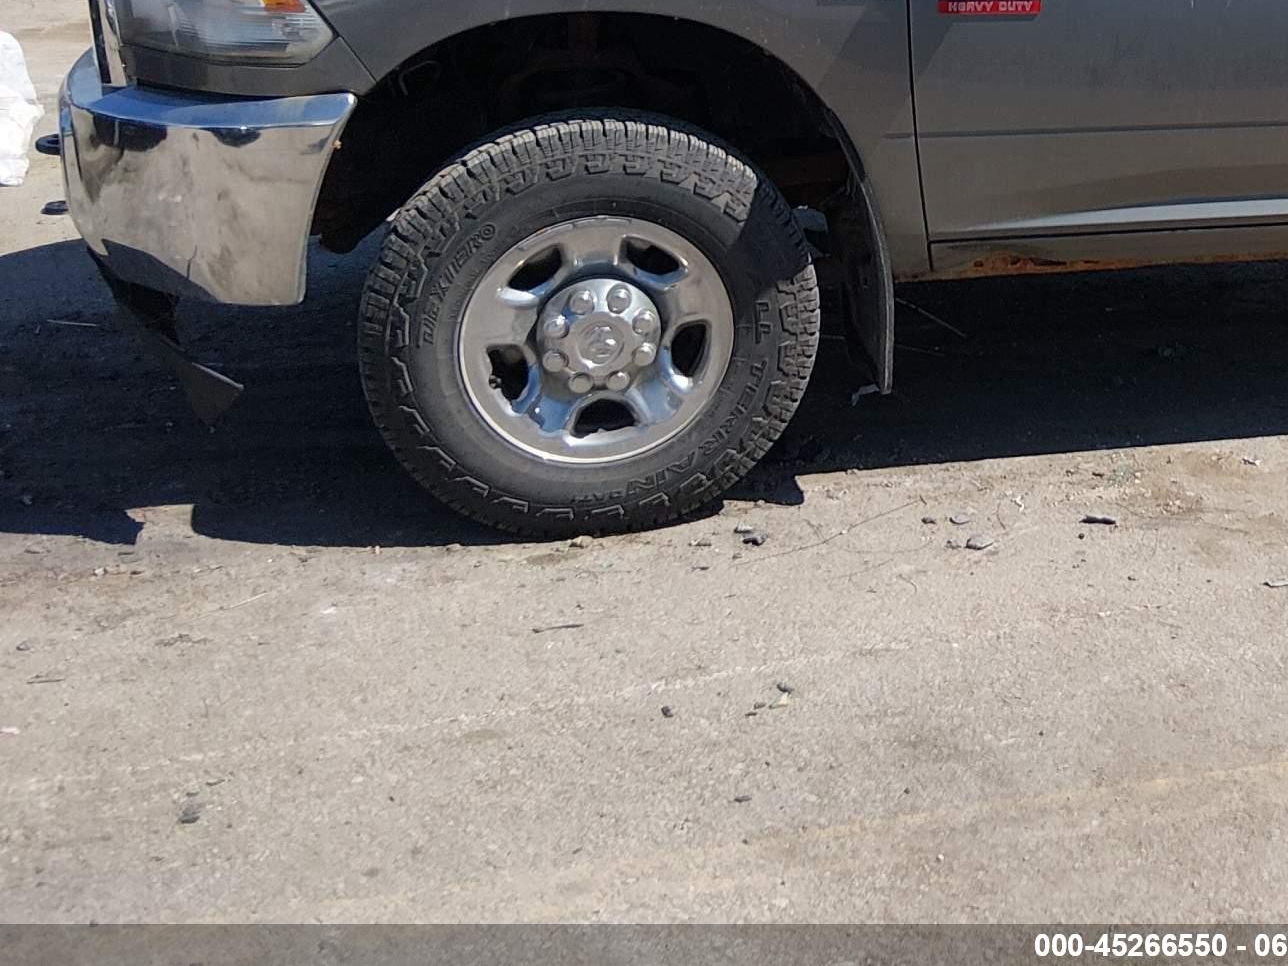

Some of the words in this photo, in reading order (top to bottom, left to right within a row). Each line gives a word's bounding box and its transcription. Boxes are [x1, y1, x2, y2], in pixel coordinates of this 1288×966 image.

[948, 0, 994, 12] HEAVY
[998, 0, 1033, 12] DUTY
[627, 357, 769, 496] TERRAIN
